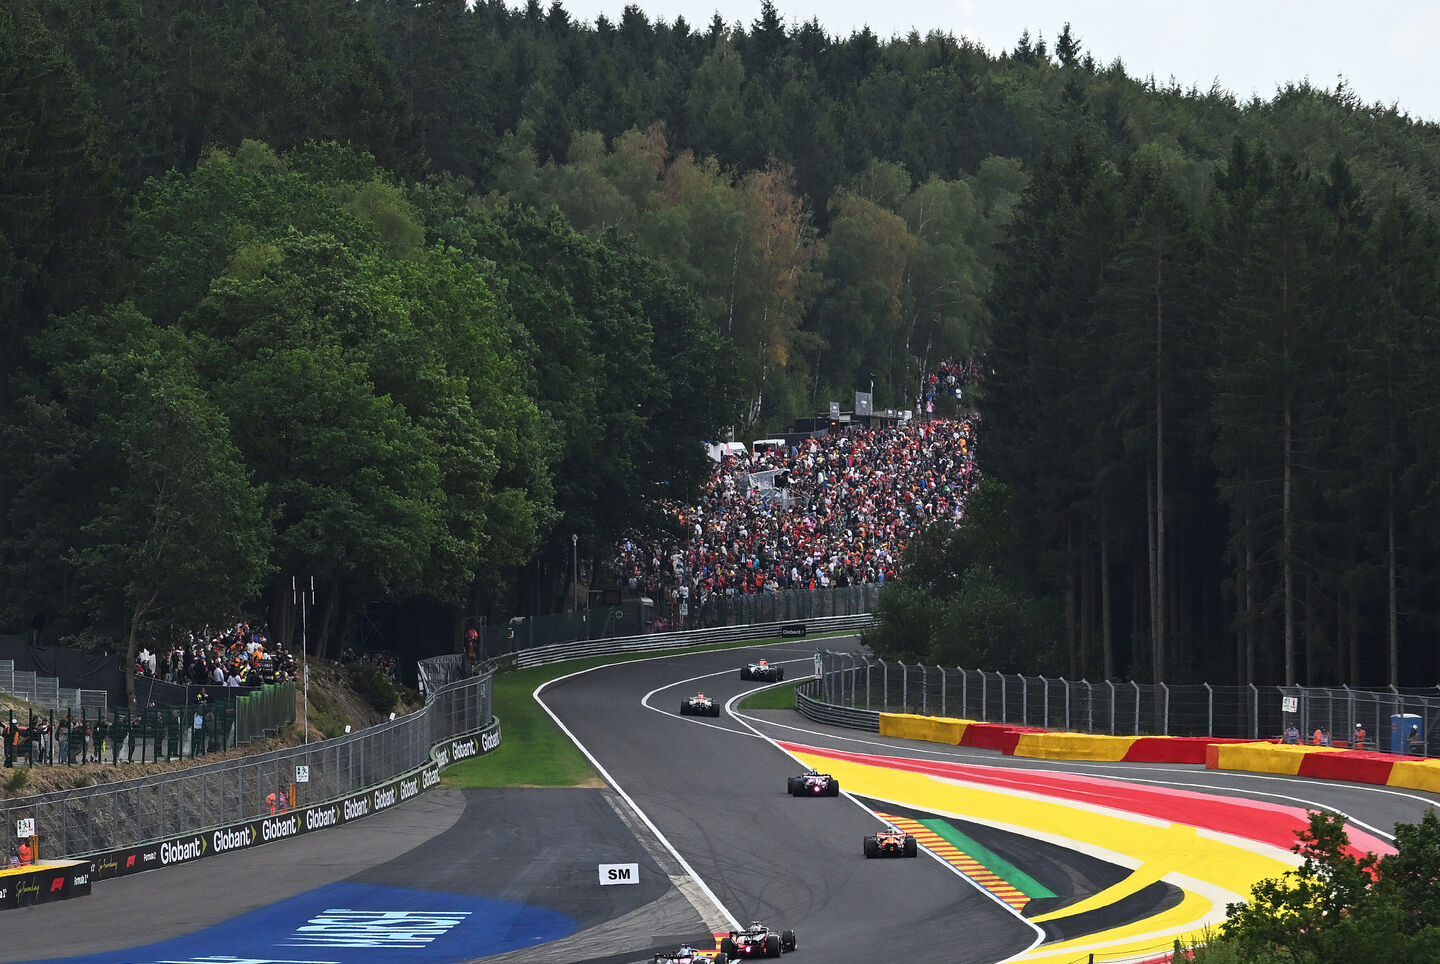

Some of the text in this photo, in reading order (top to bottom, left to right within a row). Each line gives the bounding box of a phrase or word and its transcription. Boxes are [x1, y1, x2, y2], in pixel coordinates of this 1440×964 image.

[452, 738, 476, 760] Globant
[374, 786, 395, 810] Globant
[400, 777, 418, 801] Globant
[306, 806, 336, 830] Globant
[344, 795, 368, 820] Globant
[213, 825, 251, 852] Globant
[262, 813, 297, 841] Globant
[160, 836, 201, 865] Globant
[607, 868, 631, 880] SM
